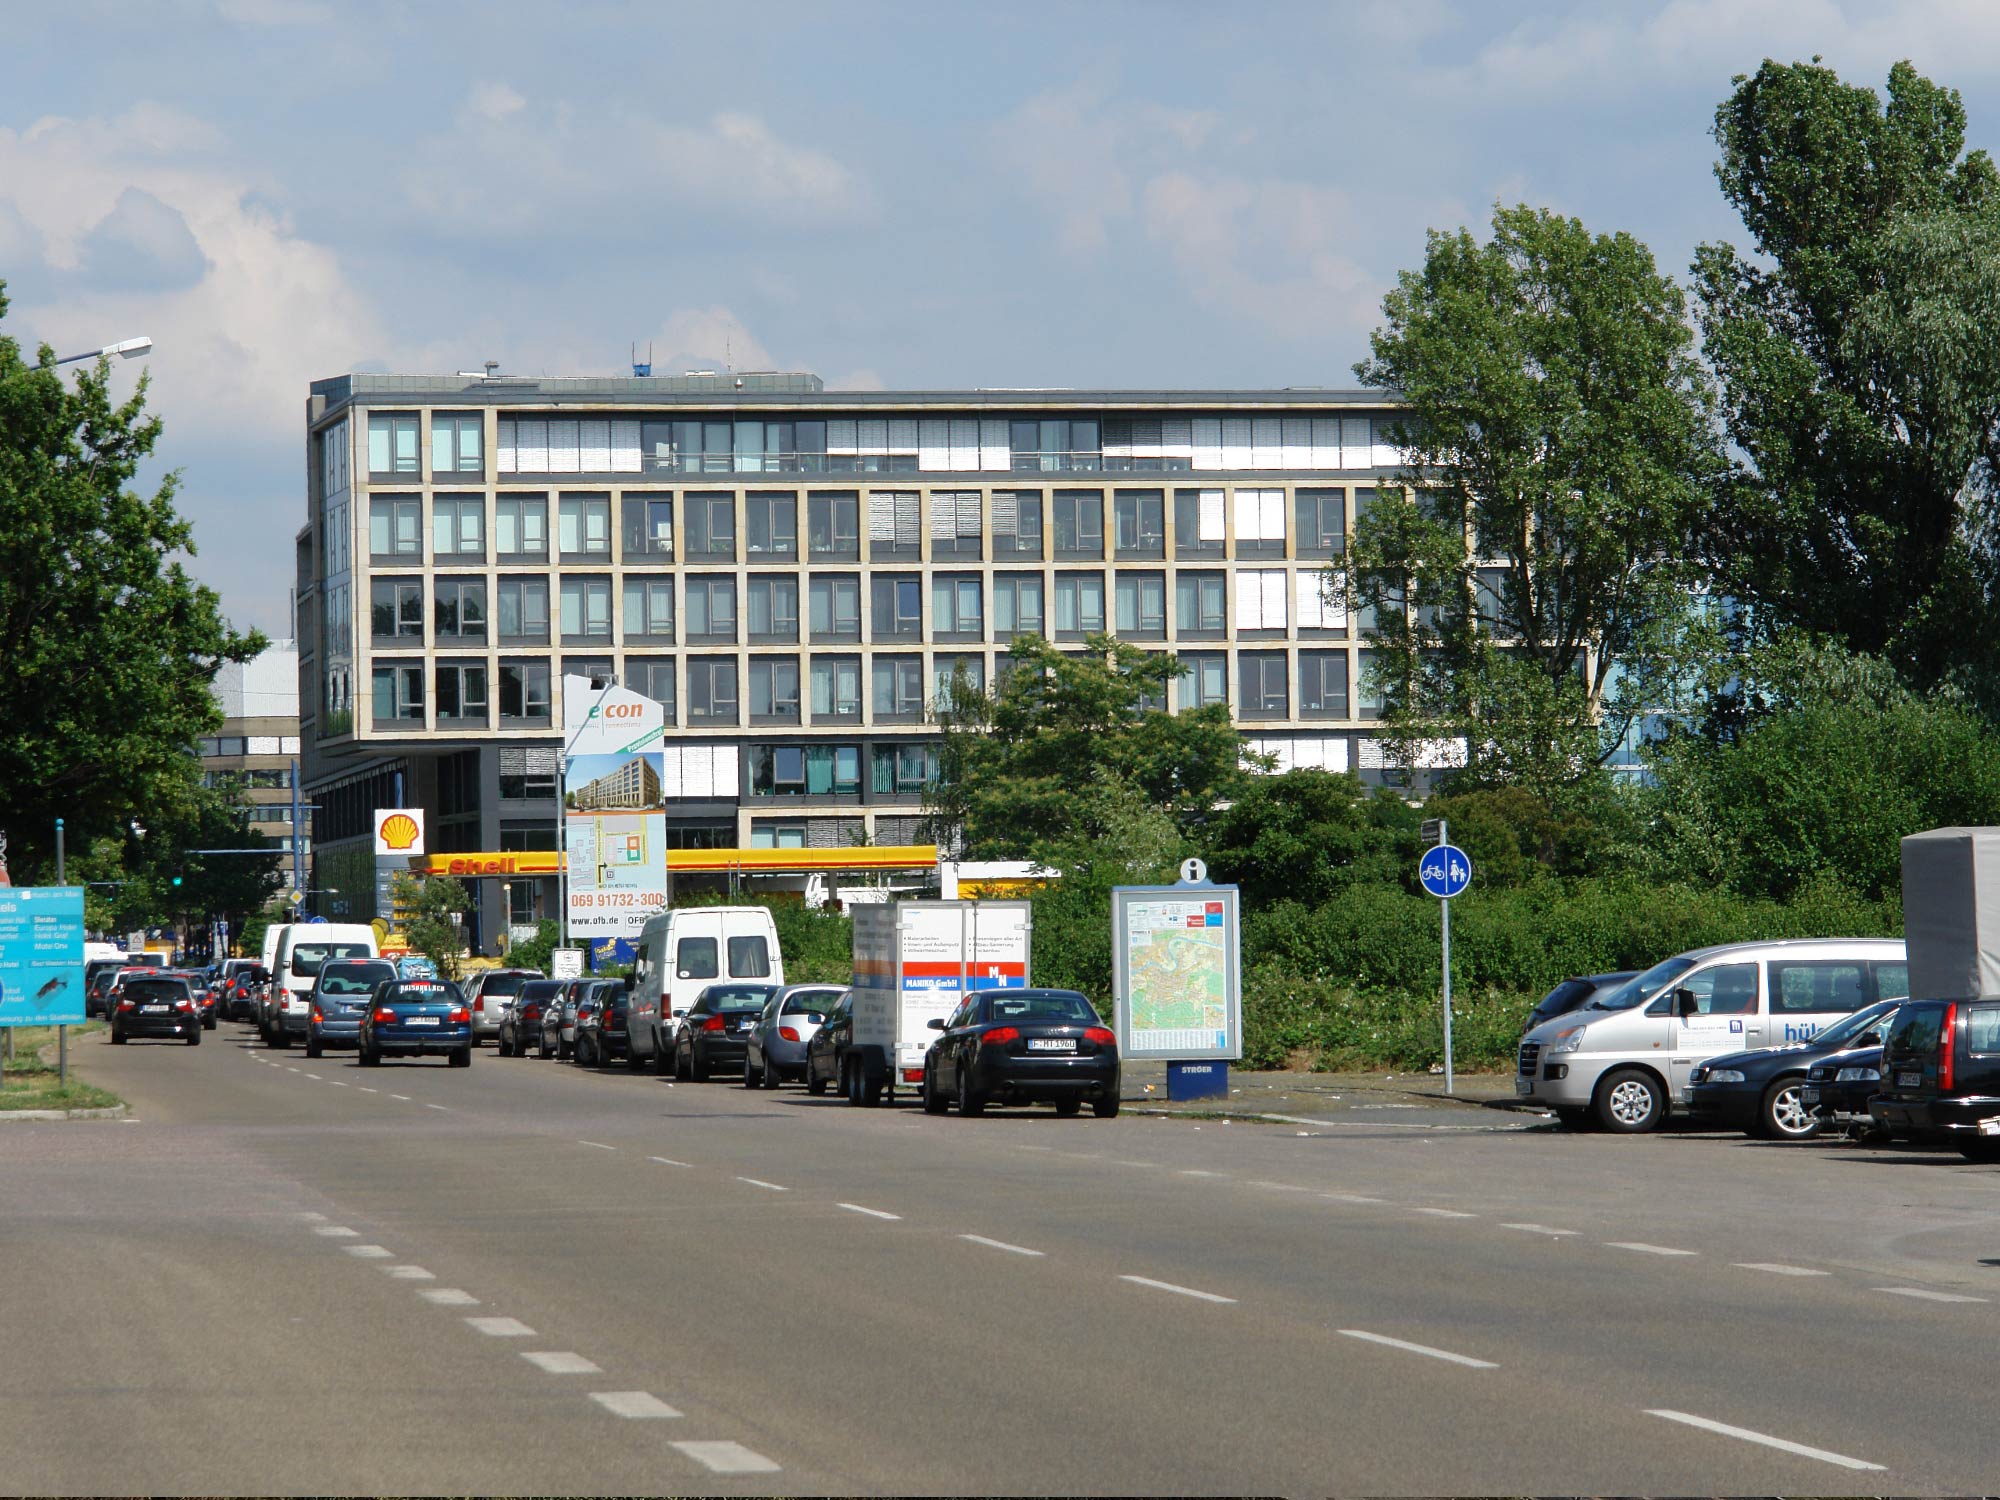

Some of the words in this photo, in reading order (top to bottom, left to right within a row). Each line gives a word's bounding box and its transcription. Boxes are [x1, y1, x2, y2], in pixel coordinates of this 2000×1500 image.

[449, 857, 515, 874] Shell
[571, 894, 593, 907] 069
[597, 893, 663, 907] 91732-300
[571, 916, 619, 925] www.ofb.de
[627, 916, 645, 925] OFB
[936, 979, 958, 987] GmbH
